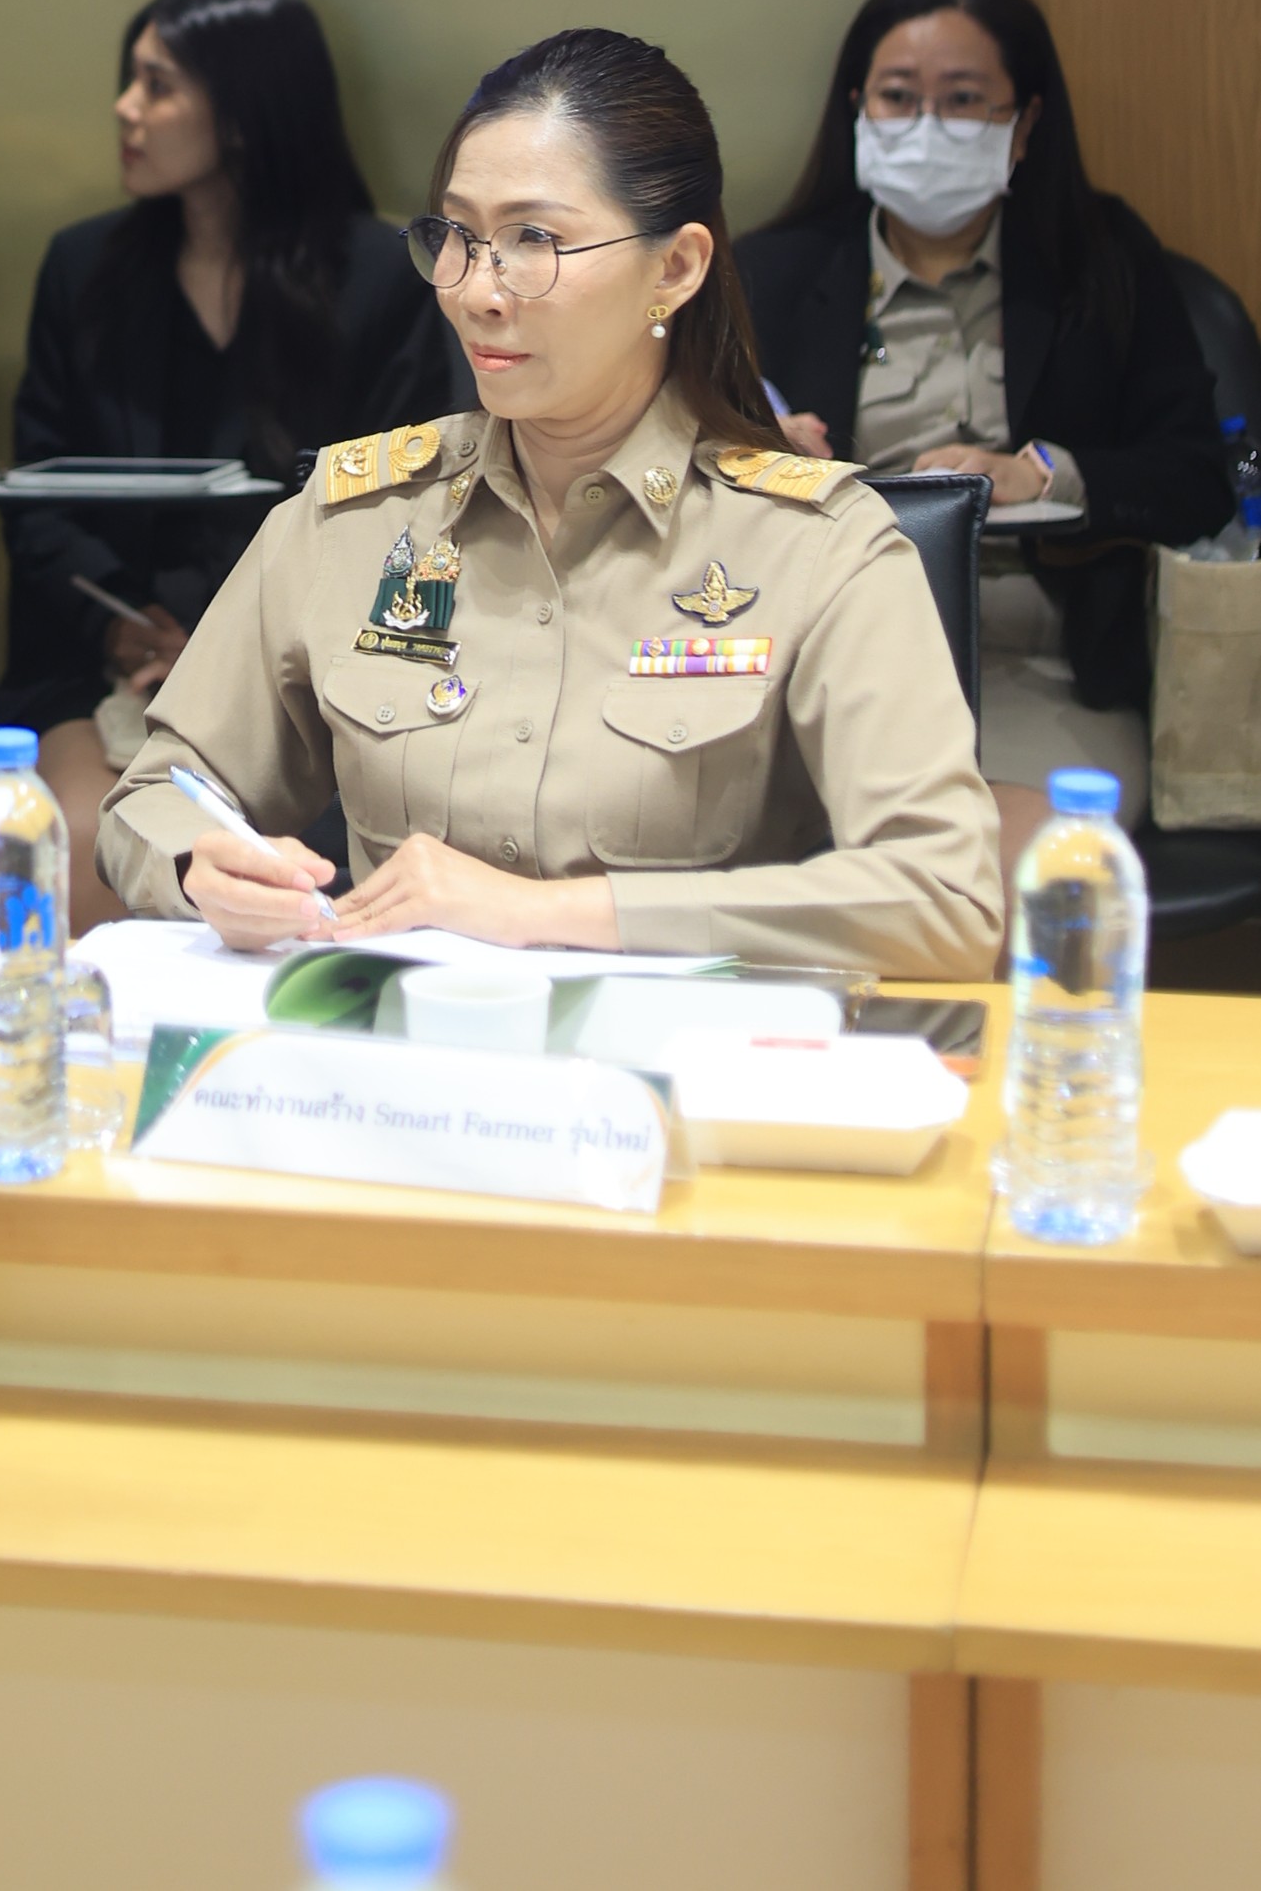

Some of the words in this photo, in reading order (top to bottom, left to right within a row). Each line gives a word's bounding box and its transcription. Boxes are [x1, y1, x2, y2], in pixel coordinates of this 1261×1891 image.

[194, 1085, 366, 1123] คณะทำงานสร้าง
[374, 1104, 451, 1134] Smart
[463, 1110, 555, 1144] Farmer
